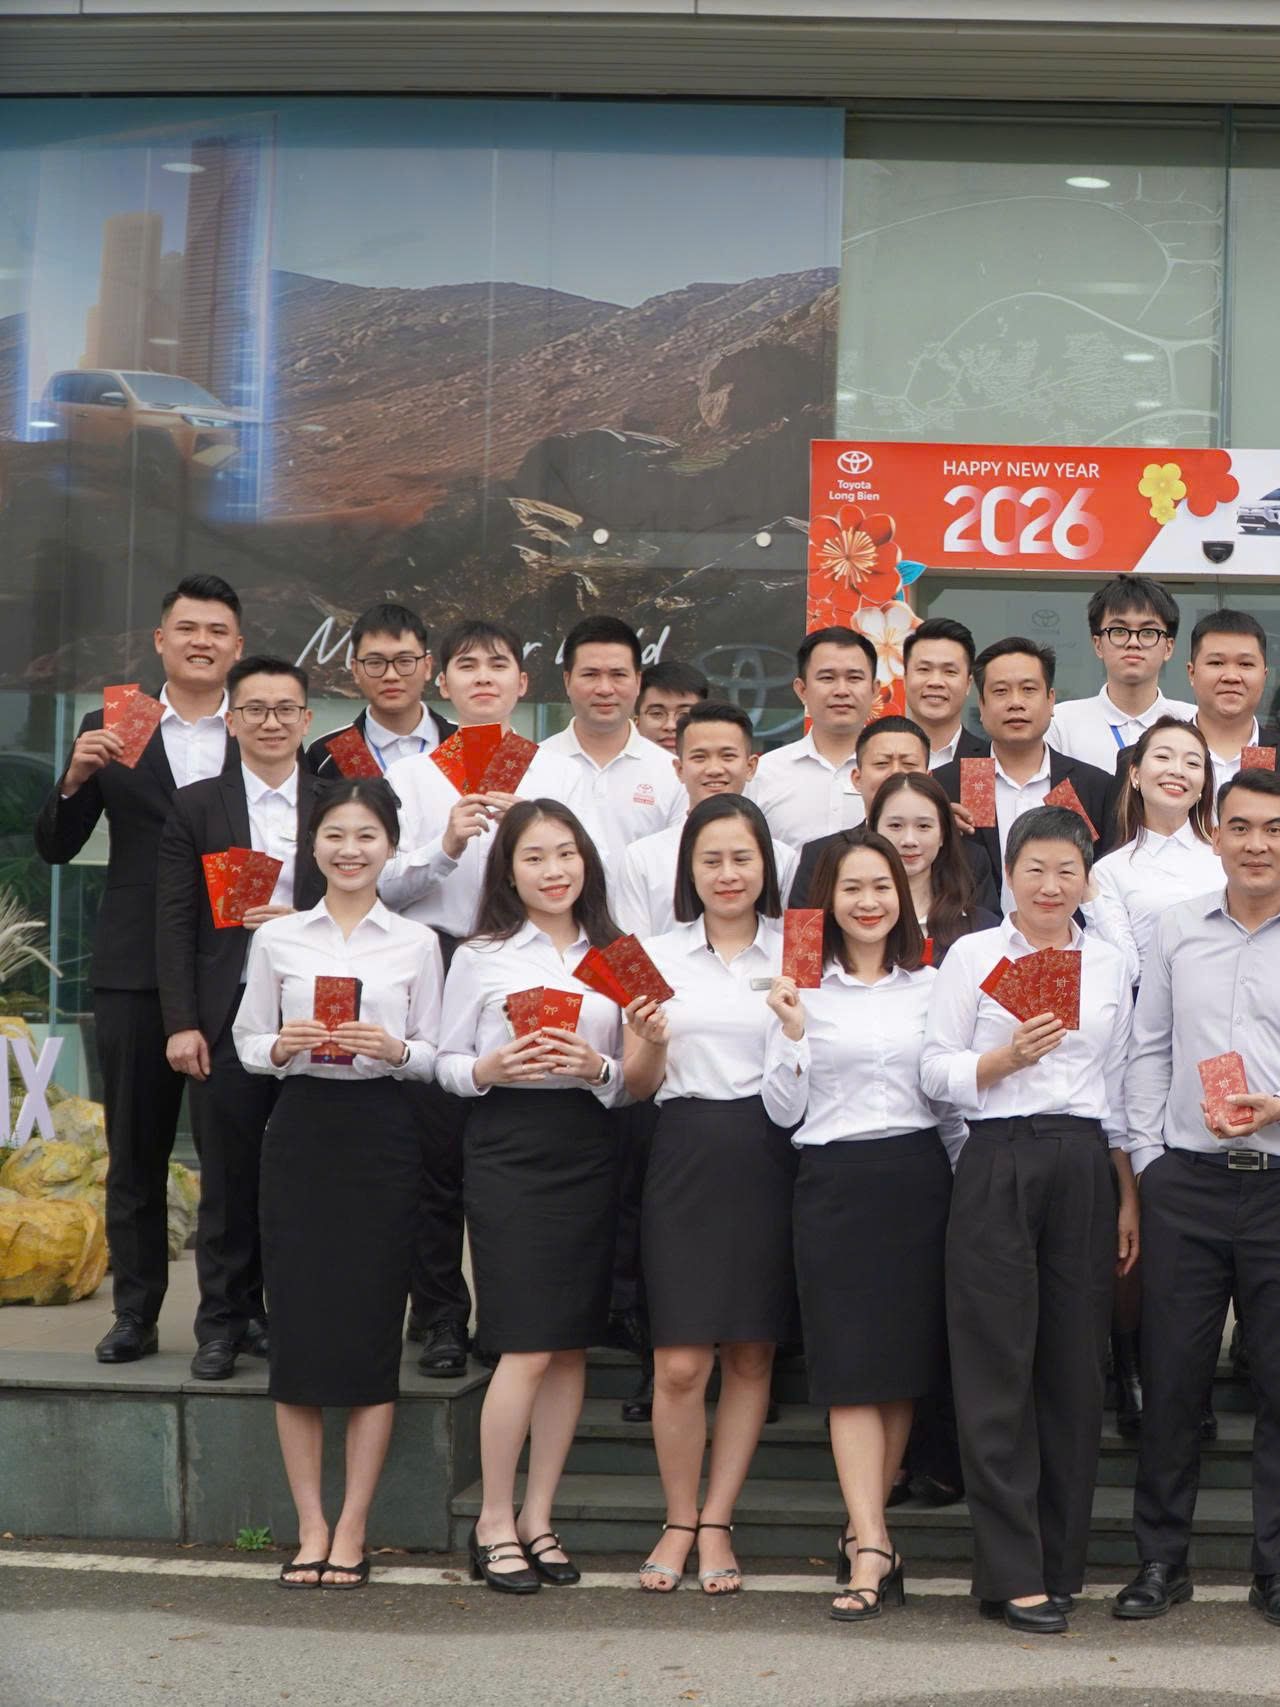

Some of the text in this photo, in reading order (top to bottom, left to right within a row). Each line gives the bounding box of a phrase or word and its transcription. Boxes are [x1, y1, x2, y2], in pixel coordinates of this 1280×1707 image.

[943, 460, 1100, 478] HAPPY NEW YEAR
[837, 479, 872, 491] Toyota
[829, 490, 880, 502] Long Bien
[943, 484, 1104, 561] 2026
